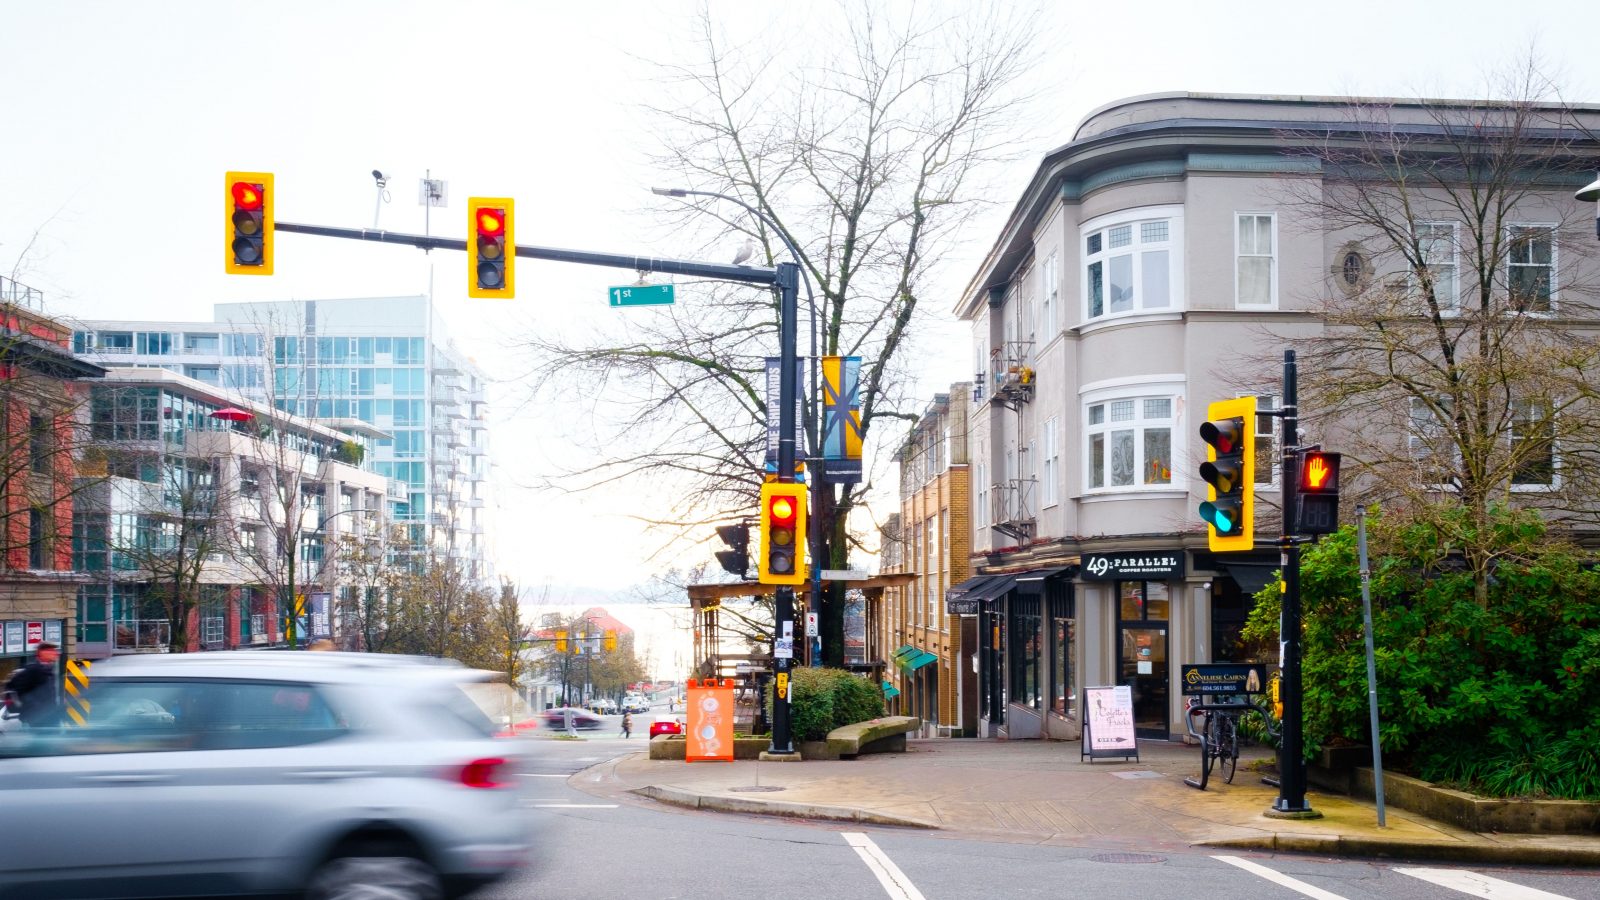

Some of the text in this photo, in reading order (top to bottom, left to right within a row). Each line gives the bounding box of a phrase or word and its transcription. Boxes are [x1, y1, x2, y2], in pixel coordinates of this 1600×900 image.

[613, 289, 632, 305] 1st
[768, 367, 780, 451] THE SHIPYARDS
[795, 429, 803, 451] LOWER
[1114, 557, 1177, 567] PARALLEL
